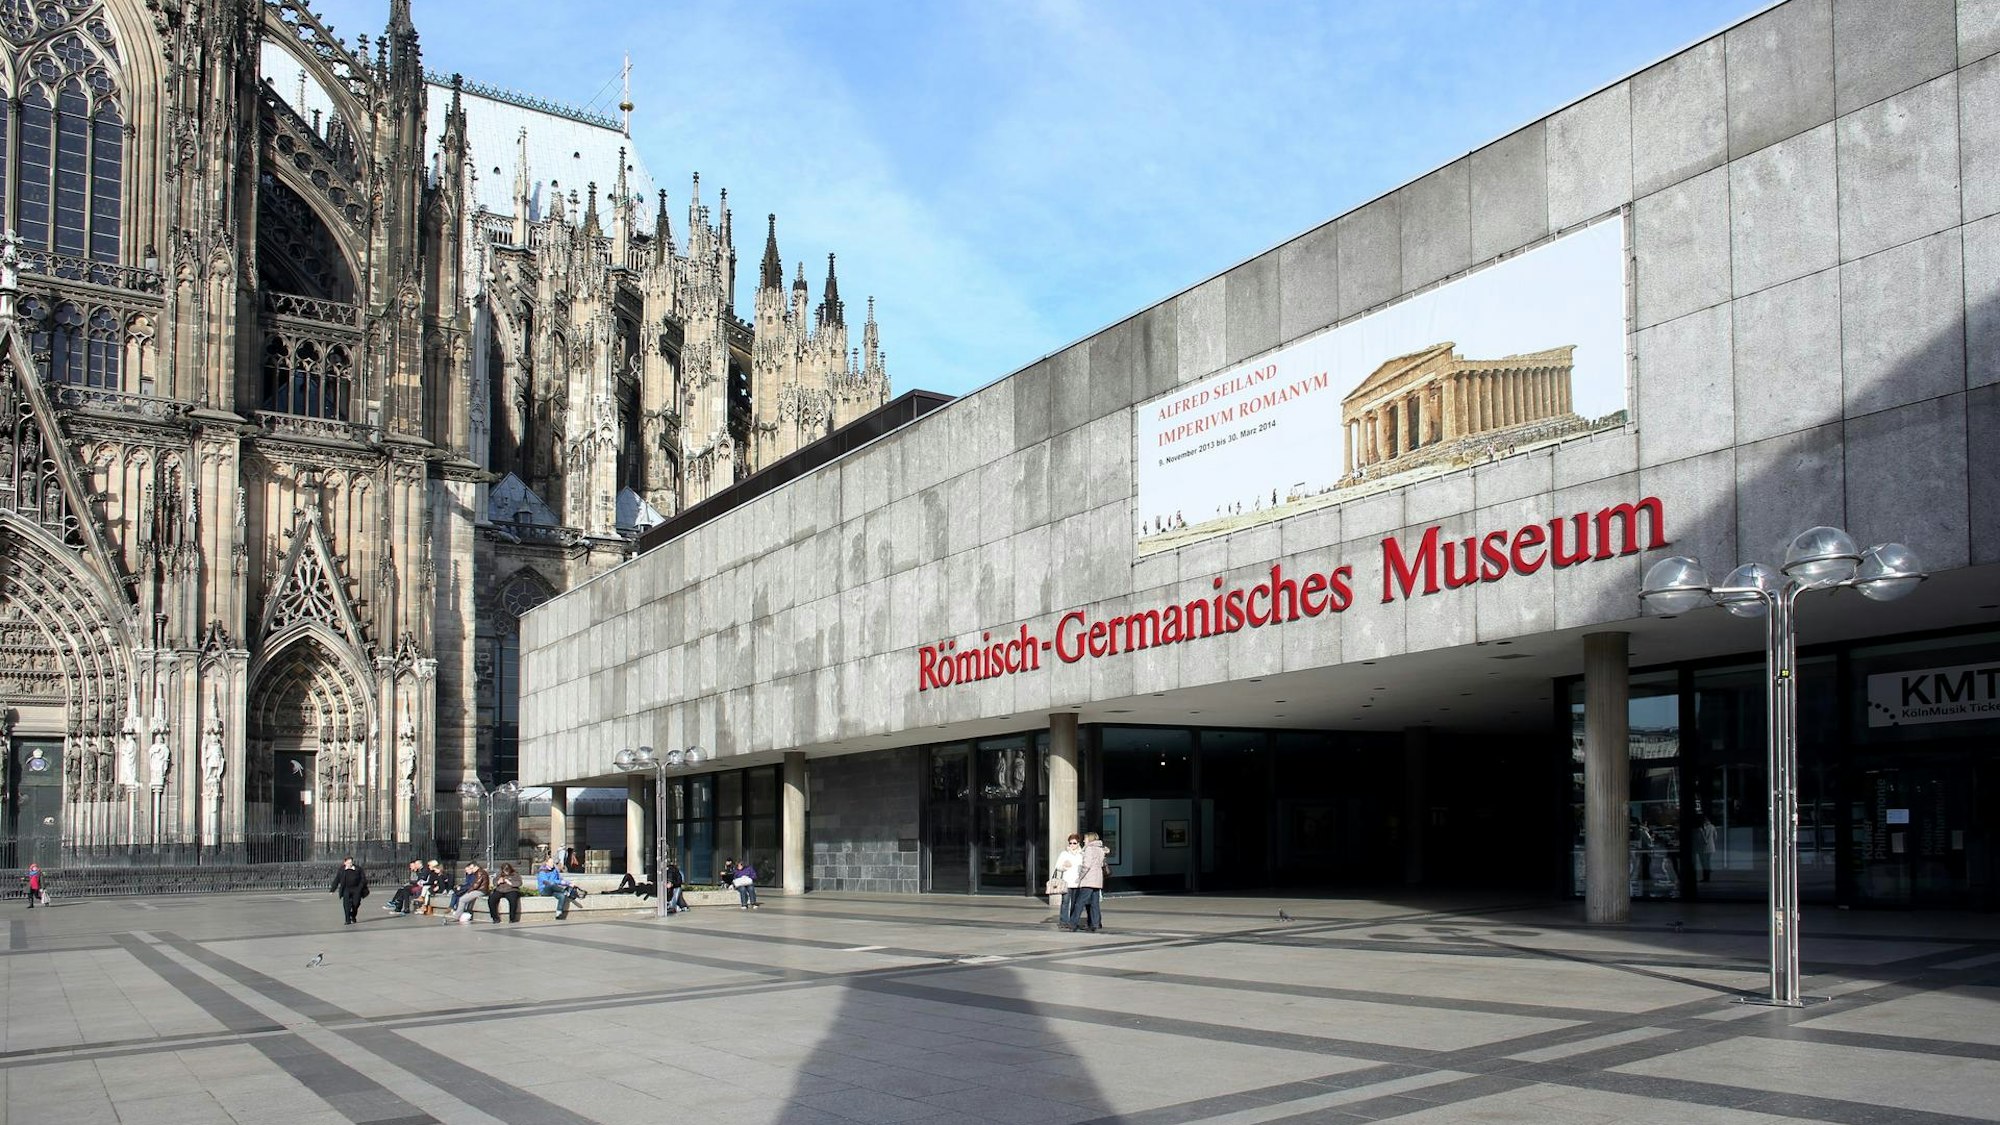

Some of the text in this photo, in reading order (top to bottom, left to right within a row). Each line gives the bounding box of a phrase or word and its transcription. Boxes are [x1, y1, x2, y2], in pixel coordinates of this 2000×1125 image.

[1158, 364, 1277, 421] ALFRED SEILAND
[1158, 372, 1329, 447] IMPERIVM ROMANVM
[1166, 447, 1197, 464] November
[1198, 441, 1215, 453] 2013
[1216, 437, 1226, 447] bis
[1228, 433, 1238, 443] 30.
[1258, 419, 1277, 432] 2014
[918, 496, 1669, 692] Römisch-Germanisches Museum
[1901, 668, 2000, 706] KMT
